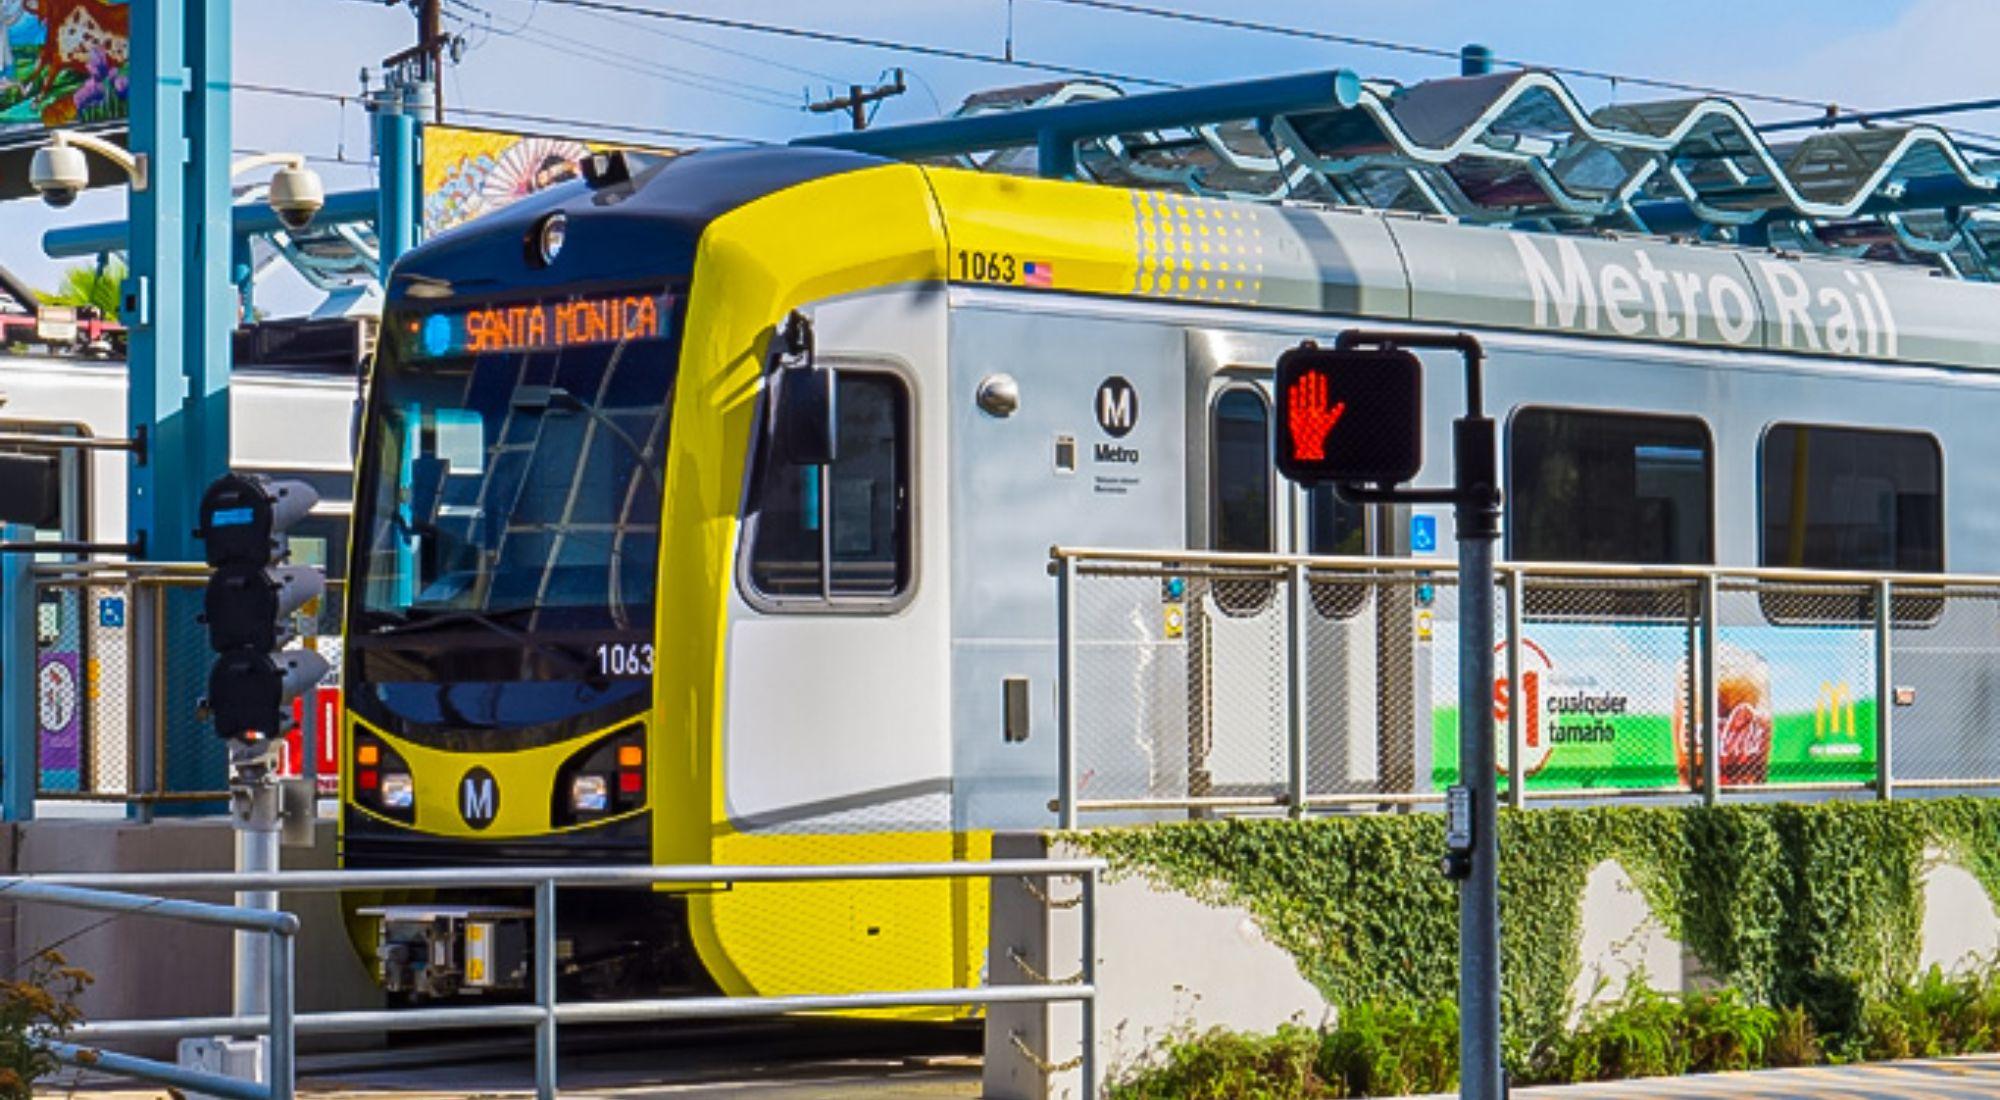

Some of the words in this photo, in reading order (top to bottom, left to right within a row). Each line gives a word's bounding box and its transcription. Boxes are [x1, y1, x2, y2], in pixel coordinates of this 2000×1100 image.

[958, 249, 1015, 283] 1063
[1510, 230, 1754, 344] Metro
[1759, 259, 1898, 356] Rail
[467, 306, 545, 351] SANTA
[555, 296, 657, 345] MONICA
[1102, 387, 1131, 428] M
[1094, 443, 1139, 464] Metro
[597, 643, 654, 675] 1063
[1547, 691, 1628, 716] cualquier
[1548, 718, 1616, 743] tamaño
[464, 778, 493, 819] M
